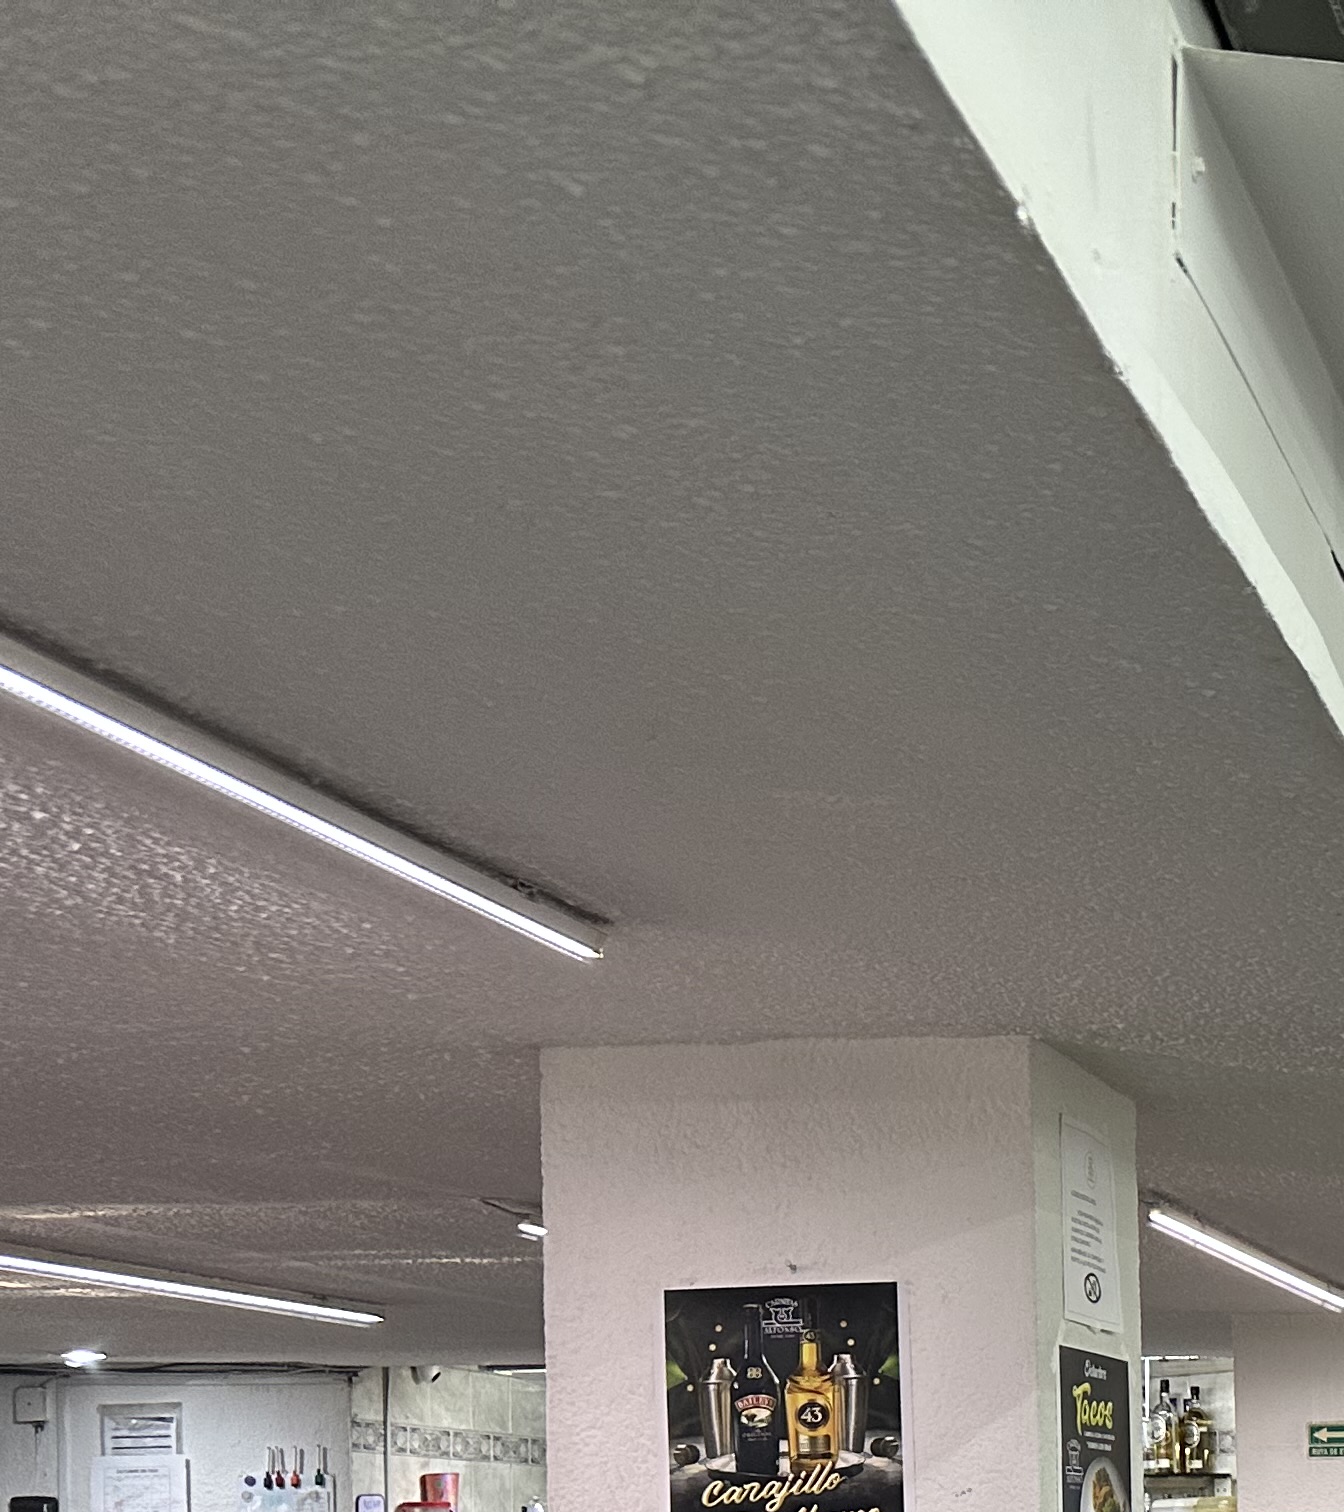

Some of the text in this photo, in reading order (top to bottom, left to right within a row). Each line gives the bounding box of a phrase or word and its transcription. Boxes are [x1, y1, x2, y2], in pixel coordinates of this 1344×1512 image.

[800, 1406, 823, 1423] 43
[1072, 1382, 1114, 1437] Tacos
[701, 1460, 847, 1512] Carajillo
